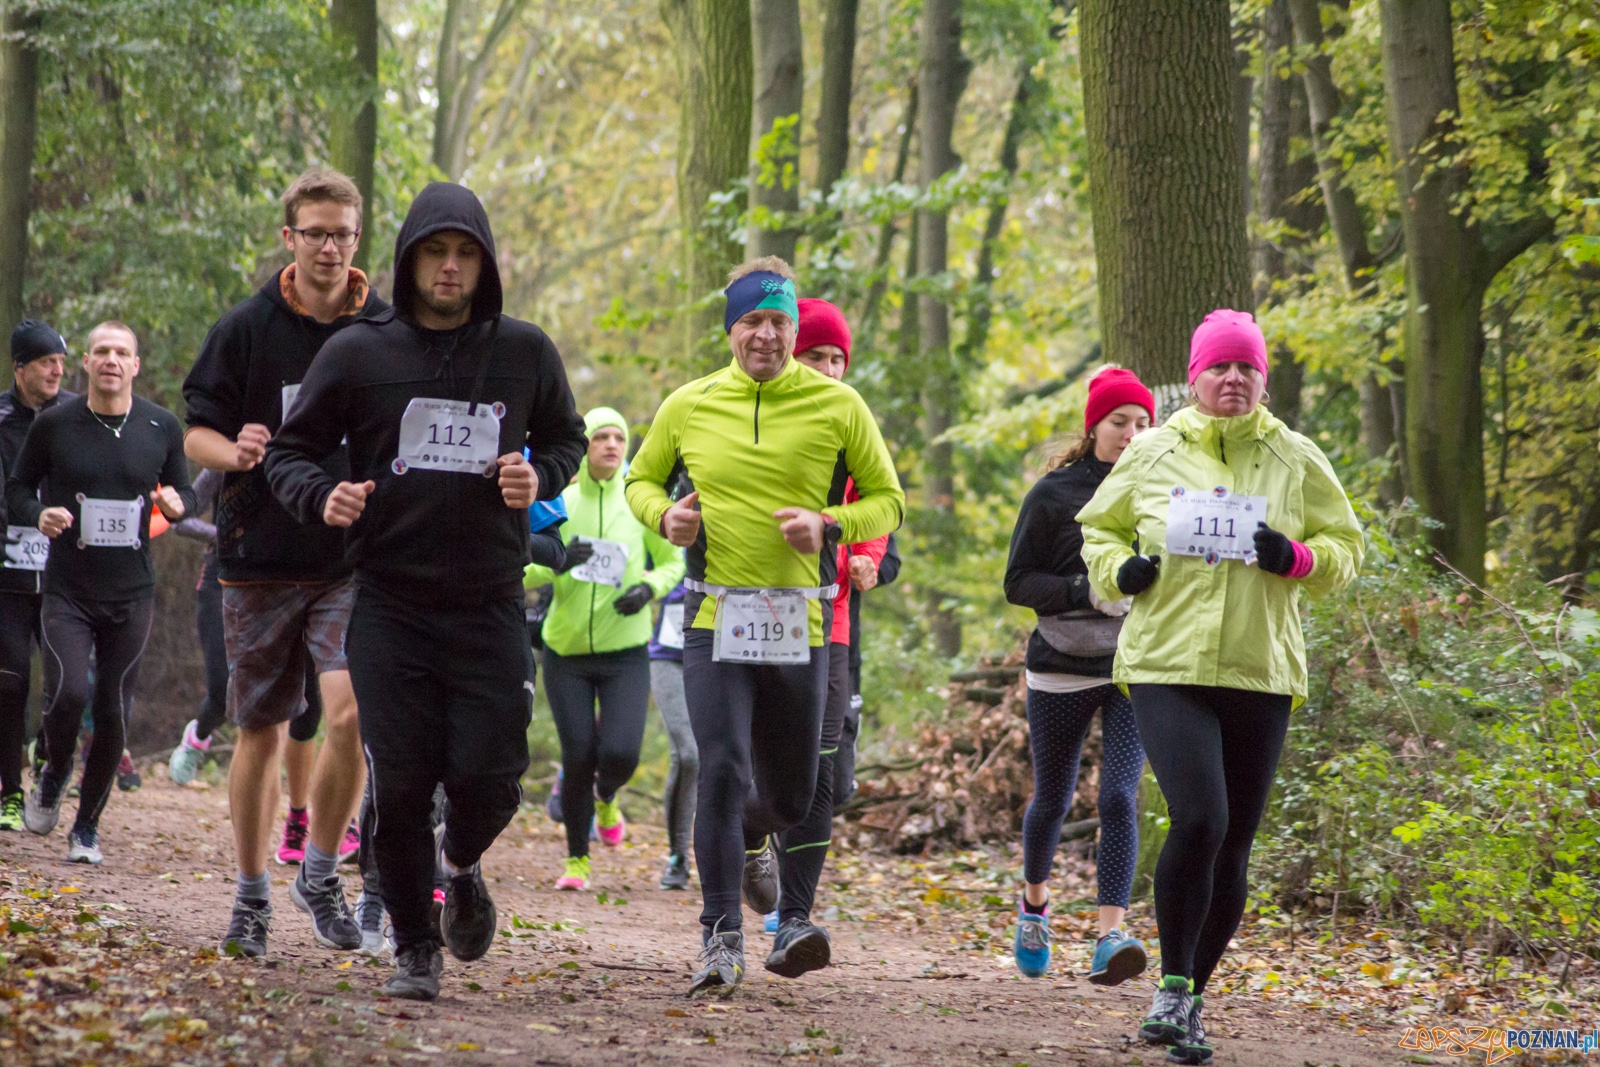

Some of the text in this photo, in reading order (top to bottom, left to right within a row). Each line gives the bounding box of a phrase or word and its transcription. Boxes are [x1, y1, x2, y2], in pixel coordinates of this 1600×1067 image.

[428, 423, 471, 447] 112
[97, 518, 126, 533] 135
[1193, 516, 1236, 538] 111
[22, 540, 50, 556] 208
[746, 622, 784, 641] 119
